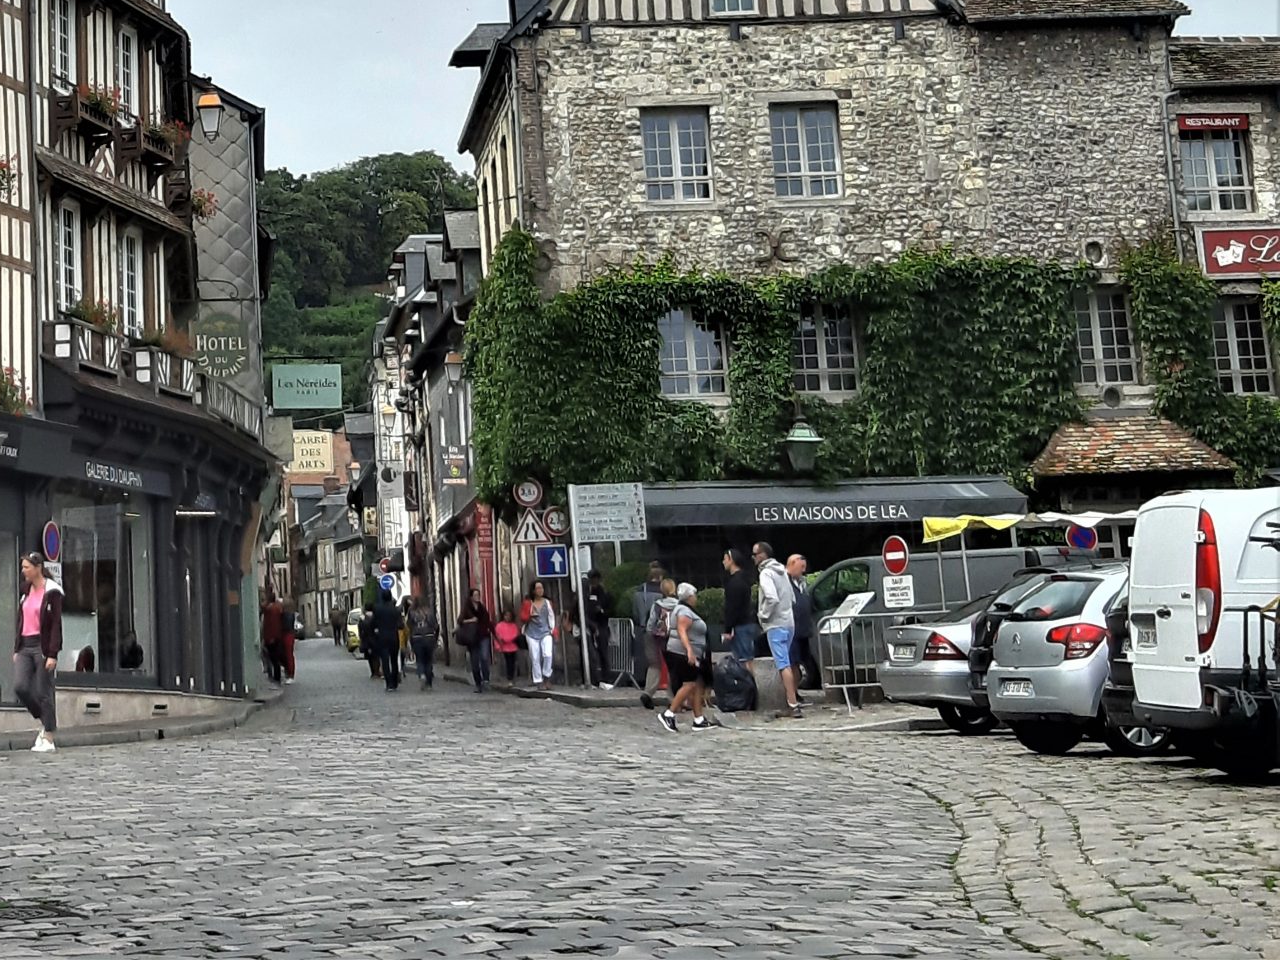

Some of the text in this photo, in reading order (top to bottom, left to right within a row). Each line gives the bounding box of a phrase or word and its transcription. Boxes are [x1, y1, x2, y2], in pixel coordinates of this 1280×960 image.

[1185, 117, 1240, 126] RESTAURANT
[196, 335, 247, 352] HOTEL
[215, 356, 228, 364] DU
[198, 354, 246, 378] DAUPHIN
[278, 378, 294, 388] Les
[301, 448, 321, 457] DES
[298, 459, 325, 468] ARTS
[754, 505, 909, 521] LES MAISONS DE LEA
